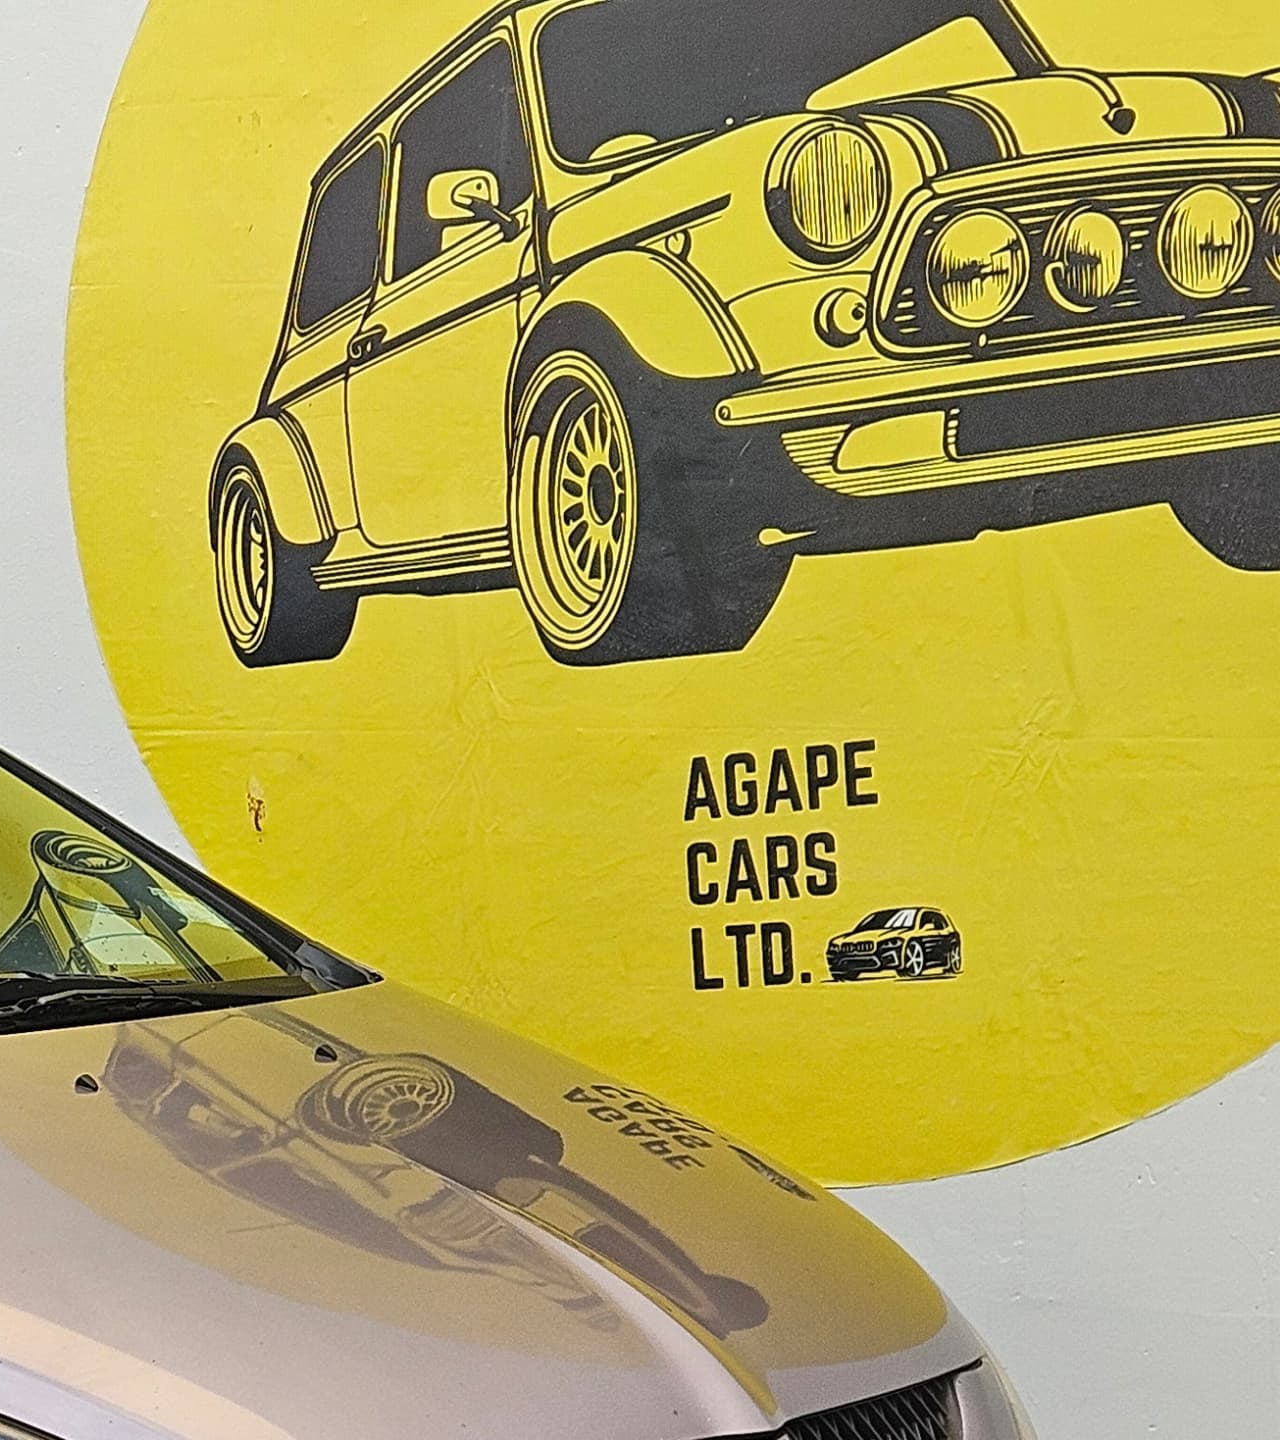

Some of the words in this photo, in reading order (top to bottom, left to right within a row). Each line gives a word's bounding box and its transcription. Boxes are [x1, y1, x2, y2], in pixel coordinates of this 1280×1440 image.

[683, 739, 879, 822] AGAPE
[686, 831, 838, 906] CARS
[690, 921, 812, 991] LTD.
